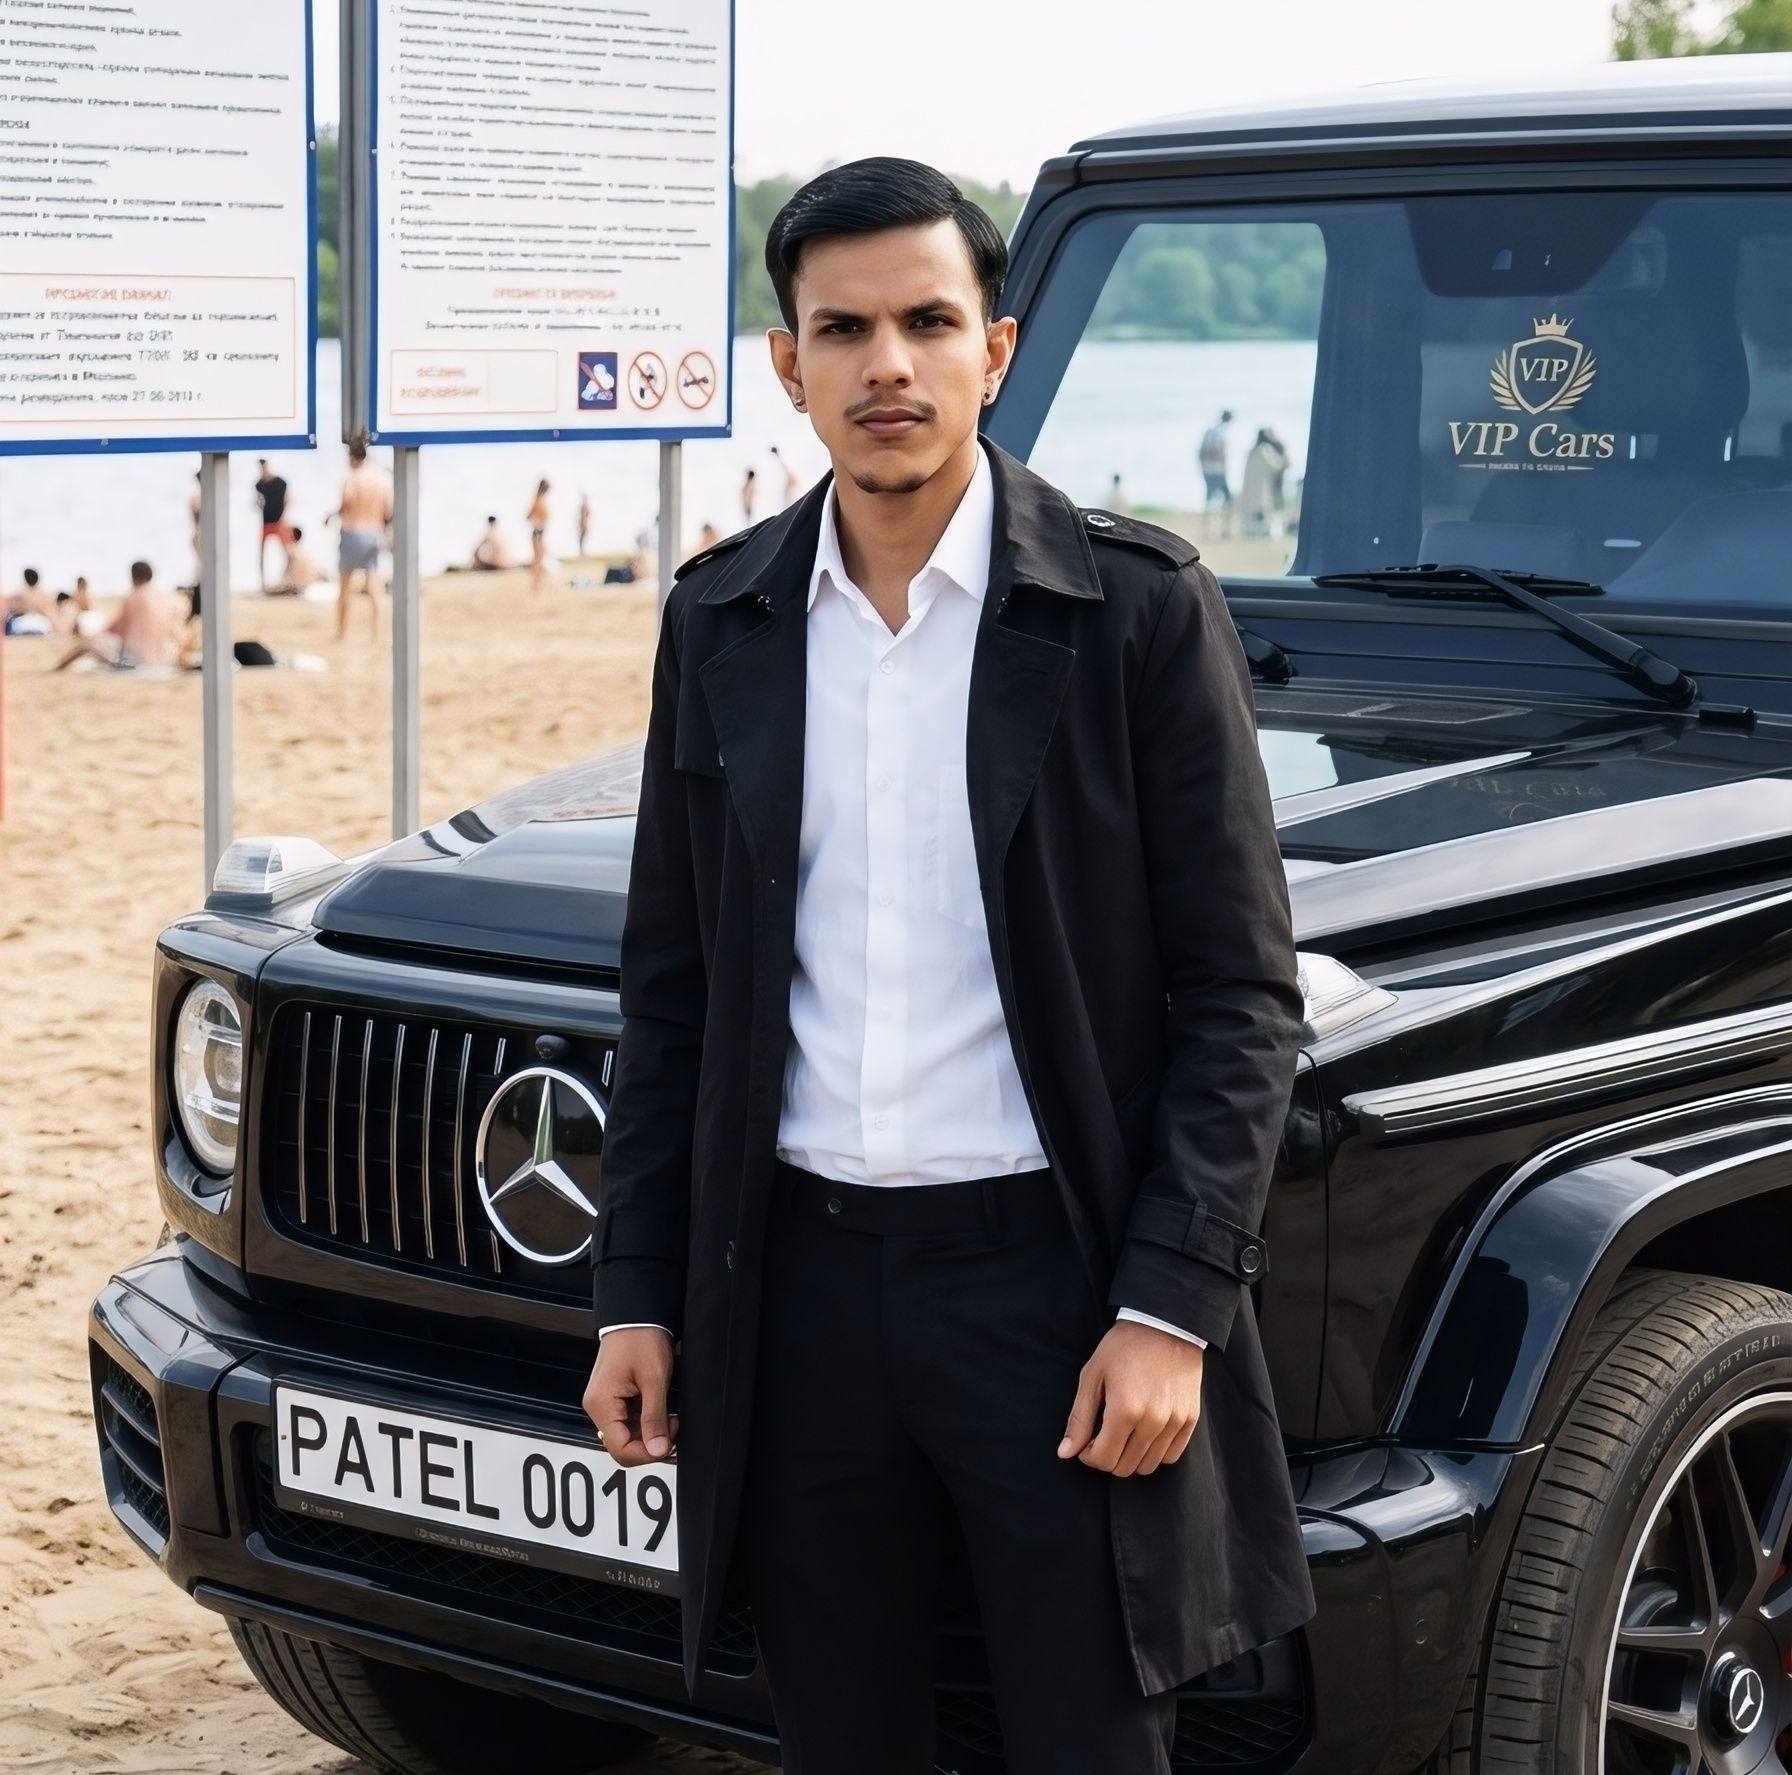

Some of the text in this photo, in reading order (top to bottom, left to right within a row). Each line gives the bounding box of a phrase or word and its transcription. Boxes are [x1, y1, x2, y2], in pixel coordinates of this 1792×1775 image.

[1520, 358, 1568, 382] VIP
[1448, 421, 1615, 459] VIP Cars
[289, 1403, 673, 1553] PATEL 0019
